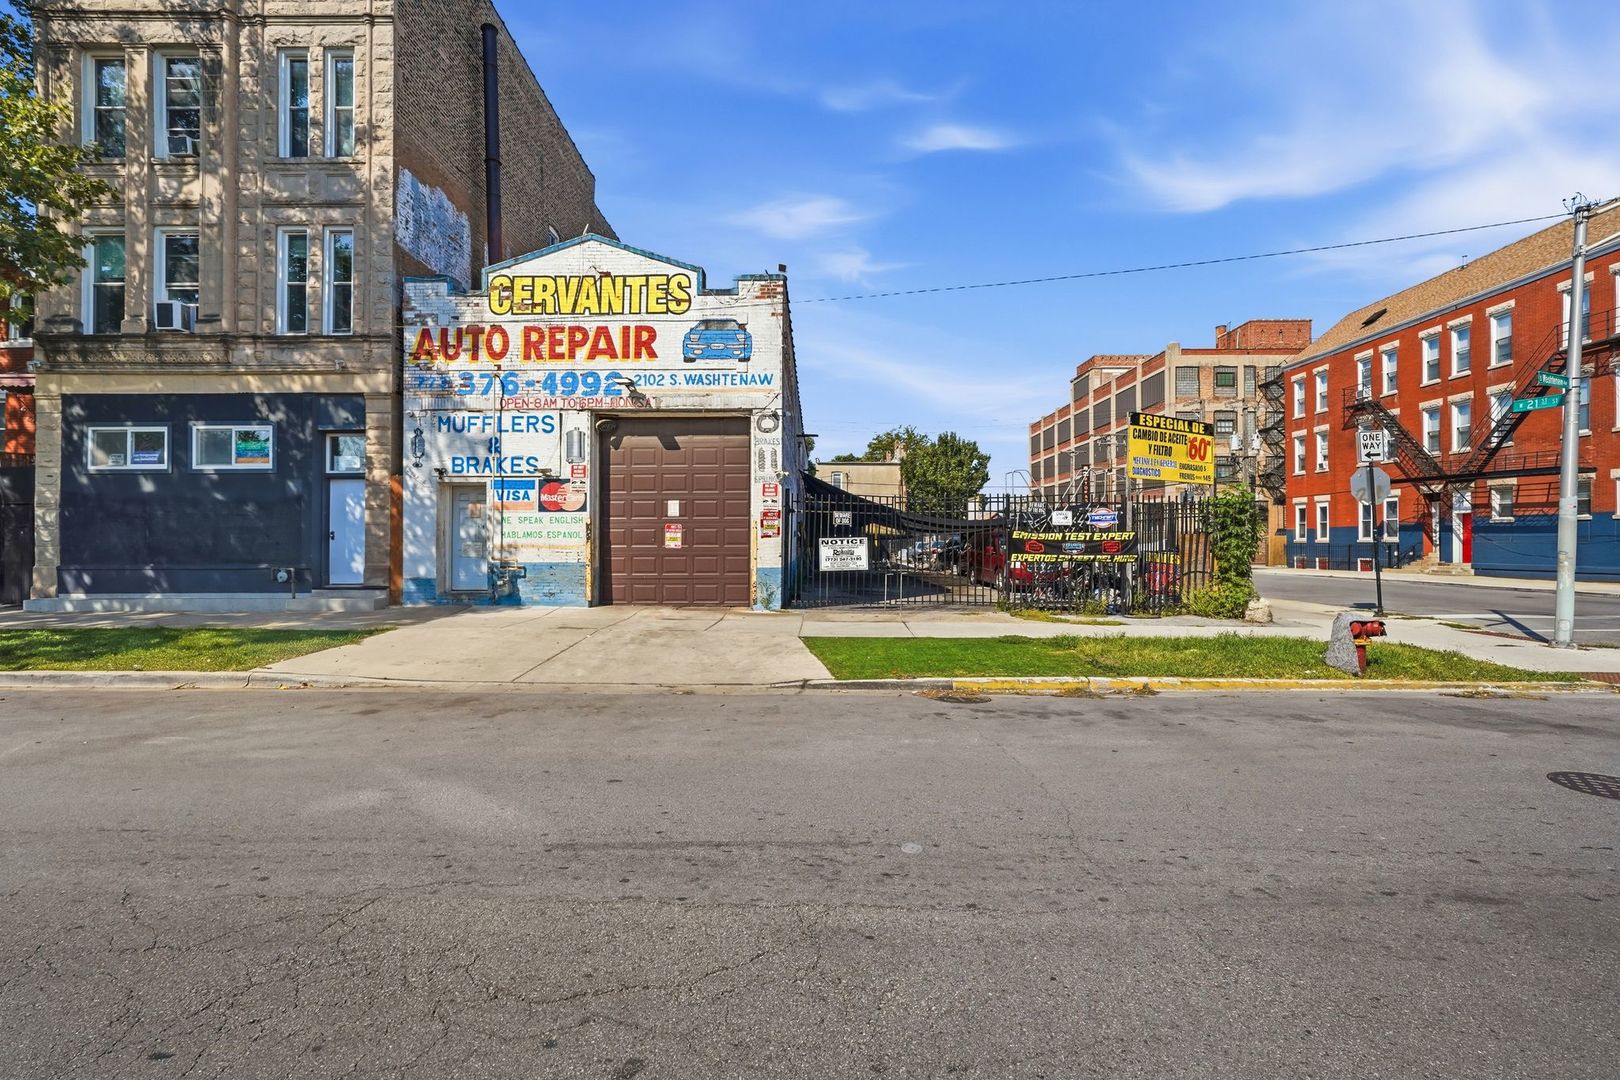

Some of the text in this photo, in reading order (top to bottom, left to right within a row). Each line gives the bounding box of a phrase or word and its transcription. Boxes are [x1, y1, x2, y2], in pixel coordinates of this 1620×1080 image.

[488, 273, 692, 315] CERVANTES
[410, 325, 659, 363] AUTO REPAIR
[455, 371, 623, 398] 376-4992
[634, 374, 774, 387] 2102 S. WASHTENAW
[437, 415, 555, 433] MUFFLERS
[1139, 414, 1205, 434] ESPECIAL DE
[1132, 428, 1188, 446] CAMBIO DE ACEITE
[1362, 433, 1381, 441] ONE
[488, 437, 501, 453] &
[1148, 443, 1173, 457] Y FILTRO
[1362, 442, 1382, 450] WAY
[452, 456, 539, 474] BRAKES
[495, 490, 531, 501] VISA
[518, 516, 544, 524] SPEAK
[549, 516, 584, 524] ENGLISH
[502, 530, 543, 539] HABLAMOS
[1012, 530, 1136, 541] EMISSION TEST EXPERT
[1010, 553, 1056, 562] EXPERTOS
